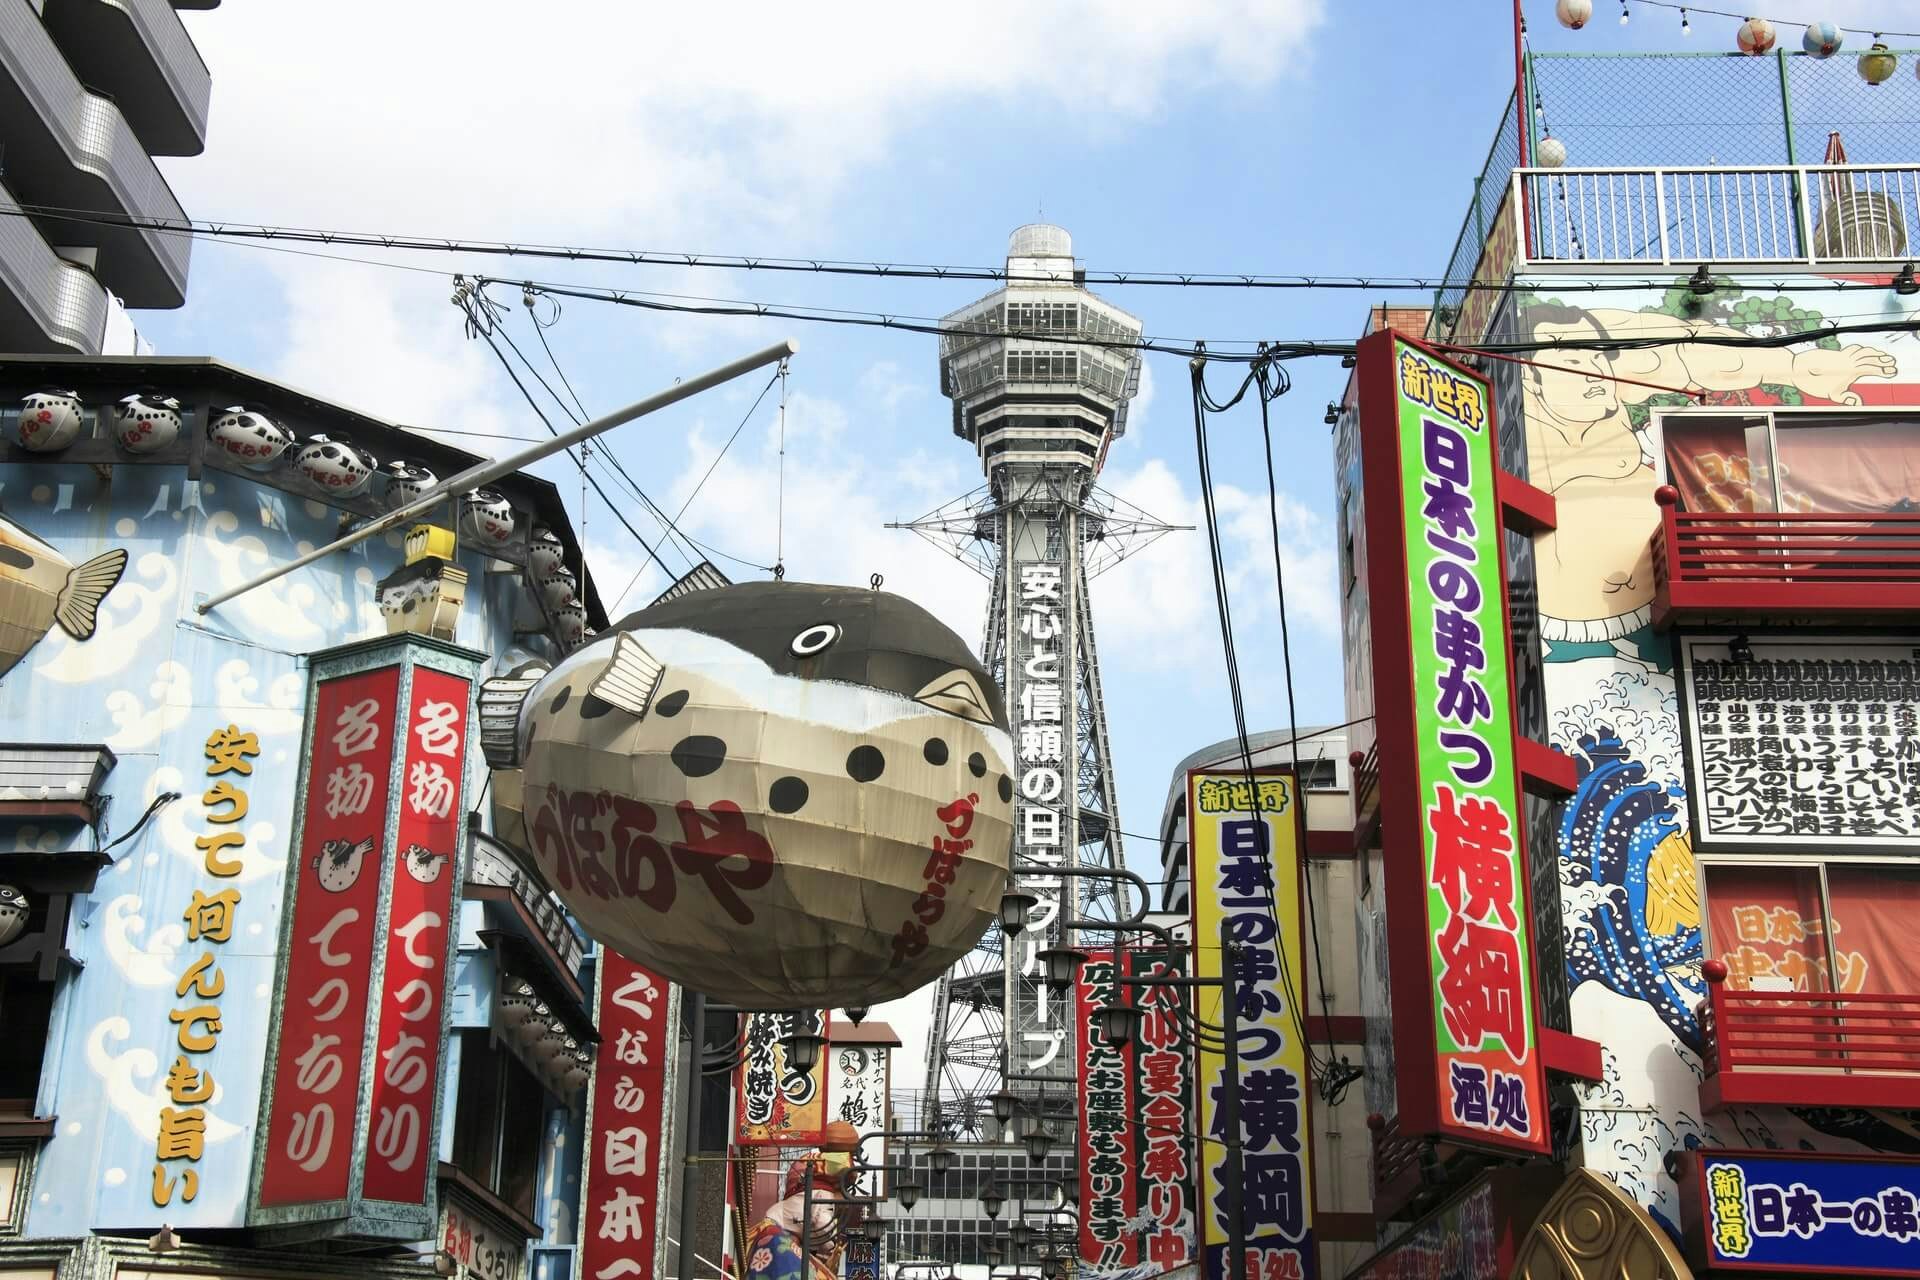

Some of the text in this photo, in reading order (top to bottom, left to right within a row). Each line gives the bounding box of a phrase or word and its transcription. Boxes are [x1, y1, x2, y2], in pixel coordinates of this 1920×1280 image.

[1401, 353, 1483, 431] 新世界
[1698, 703, 1723, 735] 変り種
[1728, 703, 1751, 734] 山の幸
[1755, 703, 1780, 735] 変り種
[1782, 704, 1807, 735] 海の幸
[1810, 703, 1835, 736] 変り種
[1837, 703, 1863, 736] 変り種
[1865, 703, 1891, 736] 変り種
[1200, 780, 1289, 813] 新世界
[1757, 737, 1793, 834] 角煮の串かつ
[1783, 738, 1820, 834] いわし梅肉
[1813, 736, 1848, 835] うずら玉子
[1867, 738, 1908, 835] もちいそべ
[286, 698, 381, 1172] 名物 てっちり
[375, 699, 459, 1172] 名物 てっちり
[1429, 786, 1526, 1062] 横綱
[1733, 905, 1841, 945] 日本一
[596, 952, 659, 1280] ぐなら日本一
[1450, 1061, 1529, 1134] 酒処
[1711, 1168, 1748, 1254] 新世界
[1752, 1187, 1920, 1239] 日本一の串
